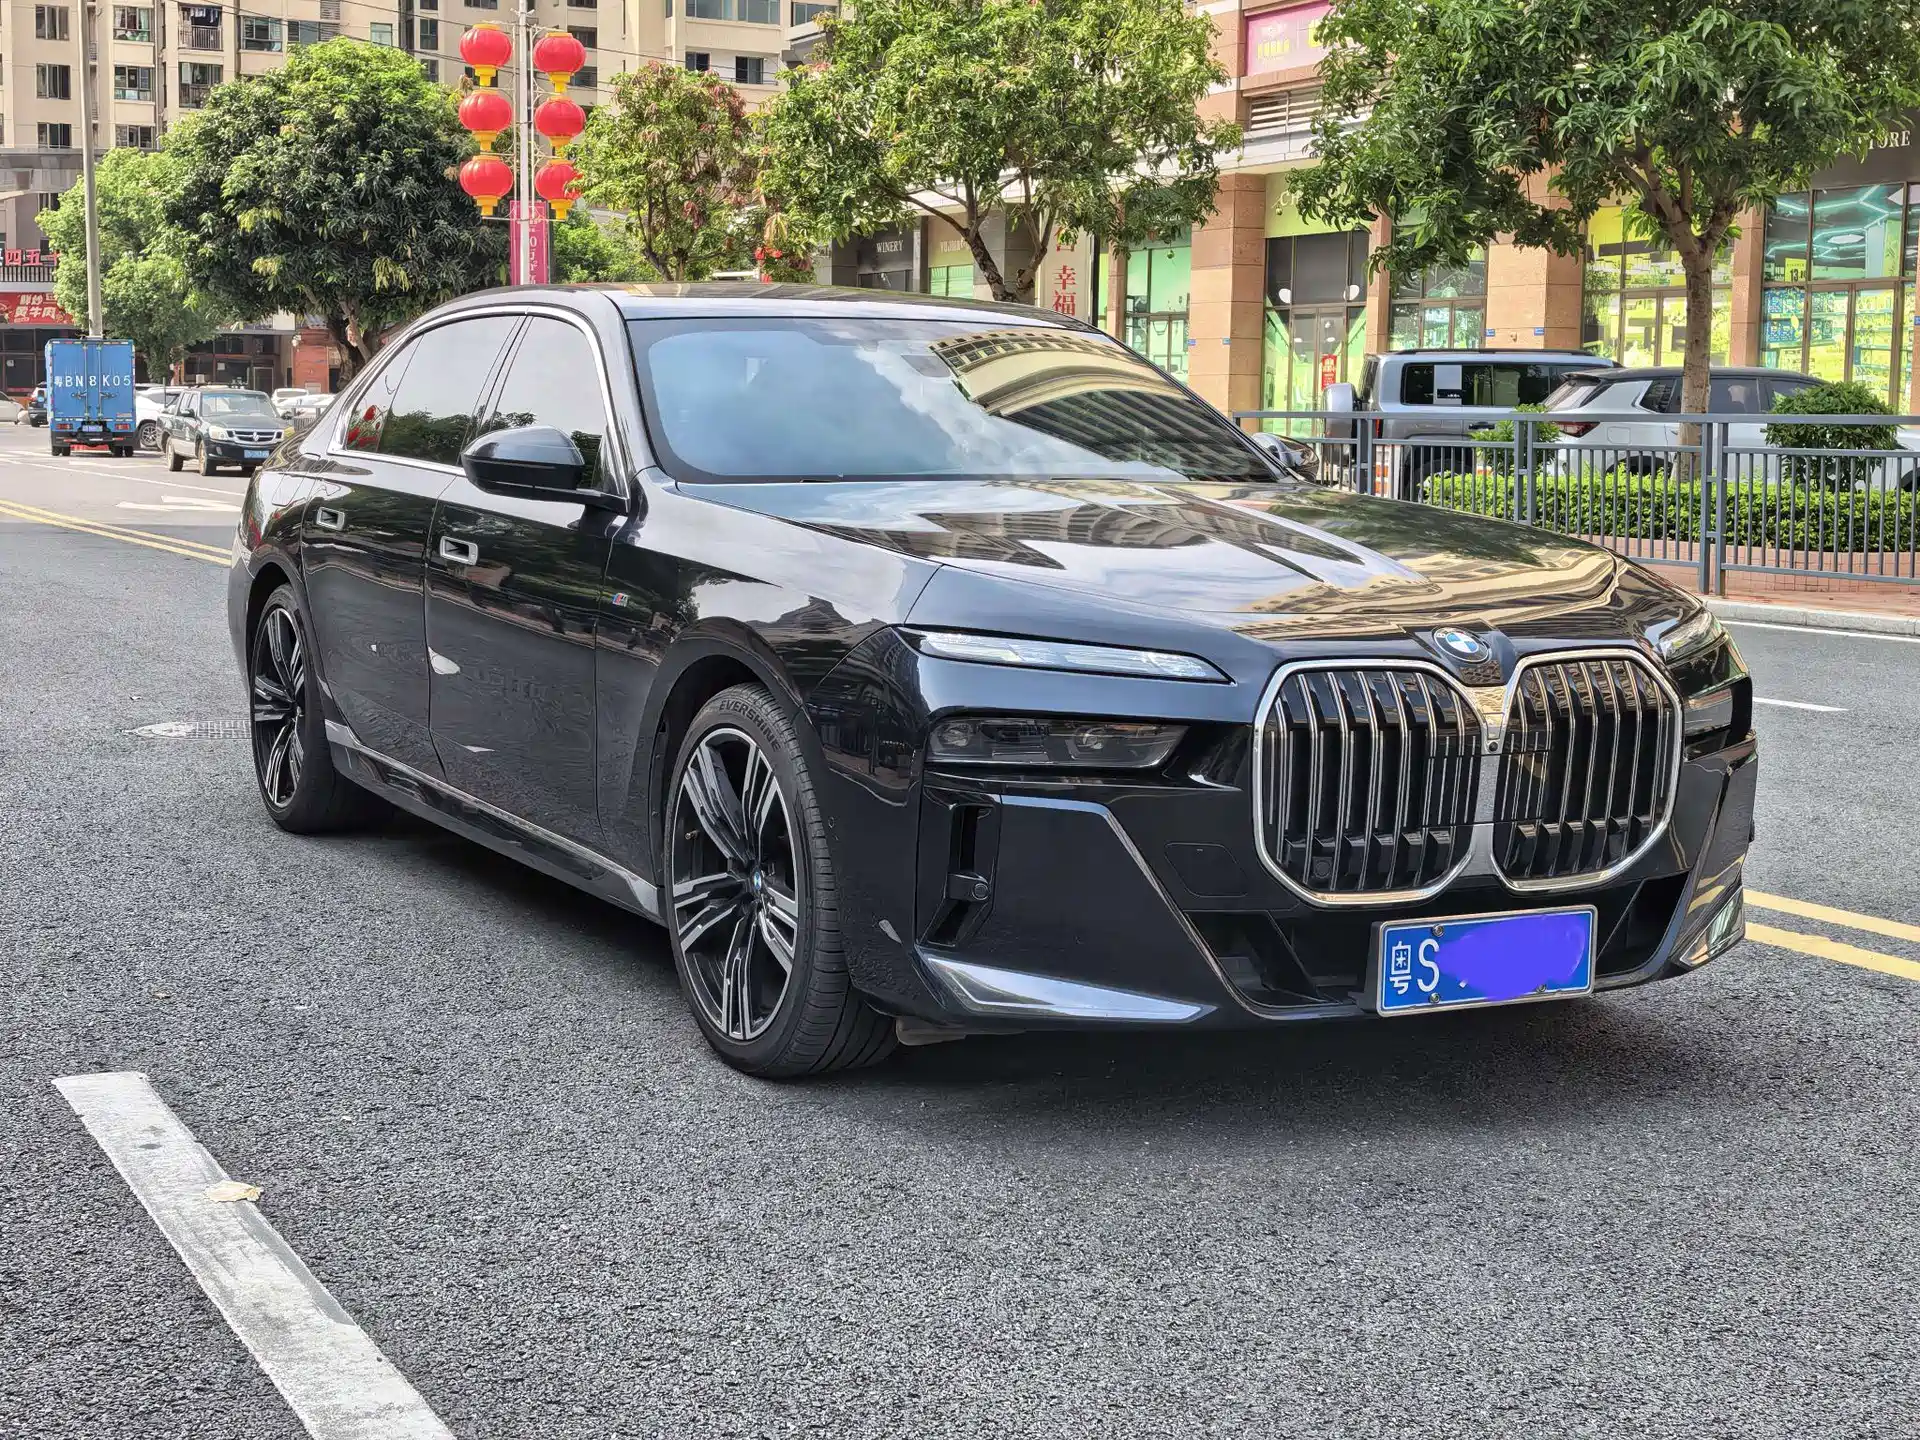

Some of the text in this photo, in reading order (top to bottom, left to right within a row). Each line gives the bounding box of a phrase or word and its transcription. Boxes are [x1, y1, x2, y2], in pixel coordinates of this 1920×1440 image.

[876, 240, 904, 253] WINERY
[1053, 265, 1077, 317] 幸福
[719, 700, 782, 752] EVERSHINE
